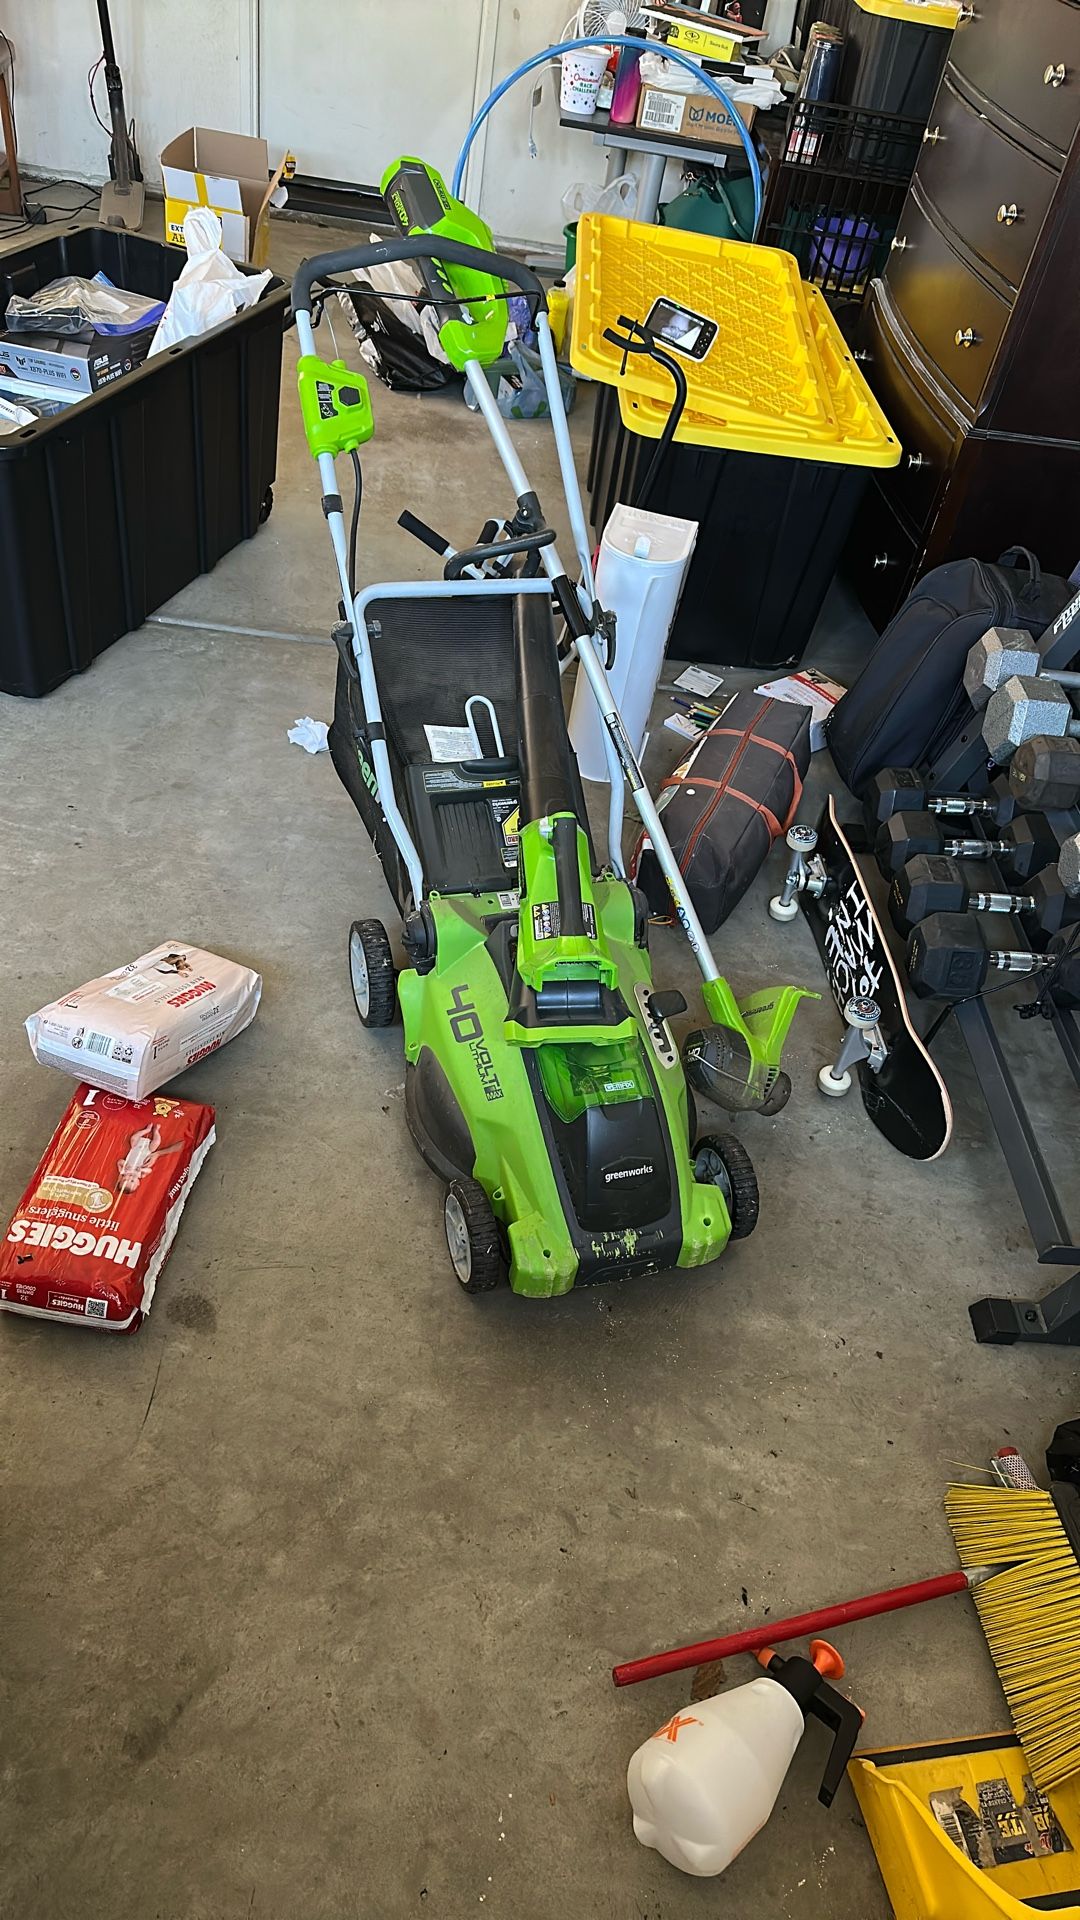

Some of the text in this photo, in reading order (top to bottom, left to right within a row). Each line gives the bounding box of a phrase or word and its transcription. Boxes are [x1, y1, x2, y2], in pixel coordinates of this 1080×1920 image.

[705, 111, 737, 127] MOE
[170, 224, 184, 233] EXT
[167, 980, 217, 1008] HUGGIES
[447, 984, 483, 1043] 40
[469, 1042, 488, 1086] LITHIUM
[476, 1038, 500, 1087] VOLT
[83, 1089, 100, 1106] 1
[486, 1089, 503, 1101] MAX
[605, 1164, 653, 1183] greenworks
[28, 1205, 120, 1232] little snugglers
[7, 1219, 142, 1269] HUGGIES
[52, 1299, 84, 1311] HUGGIES
